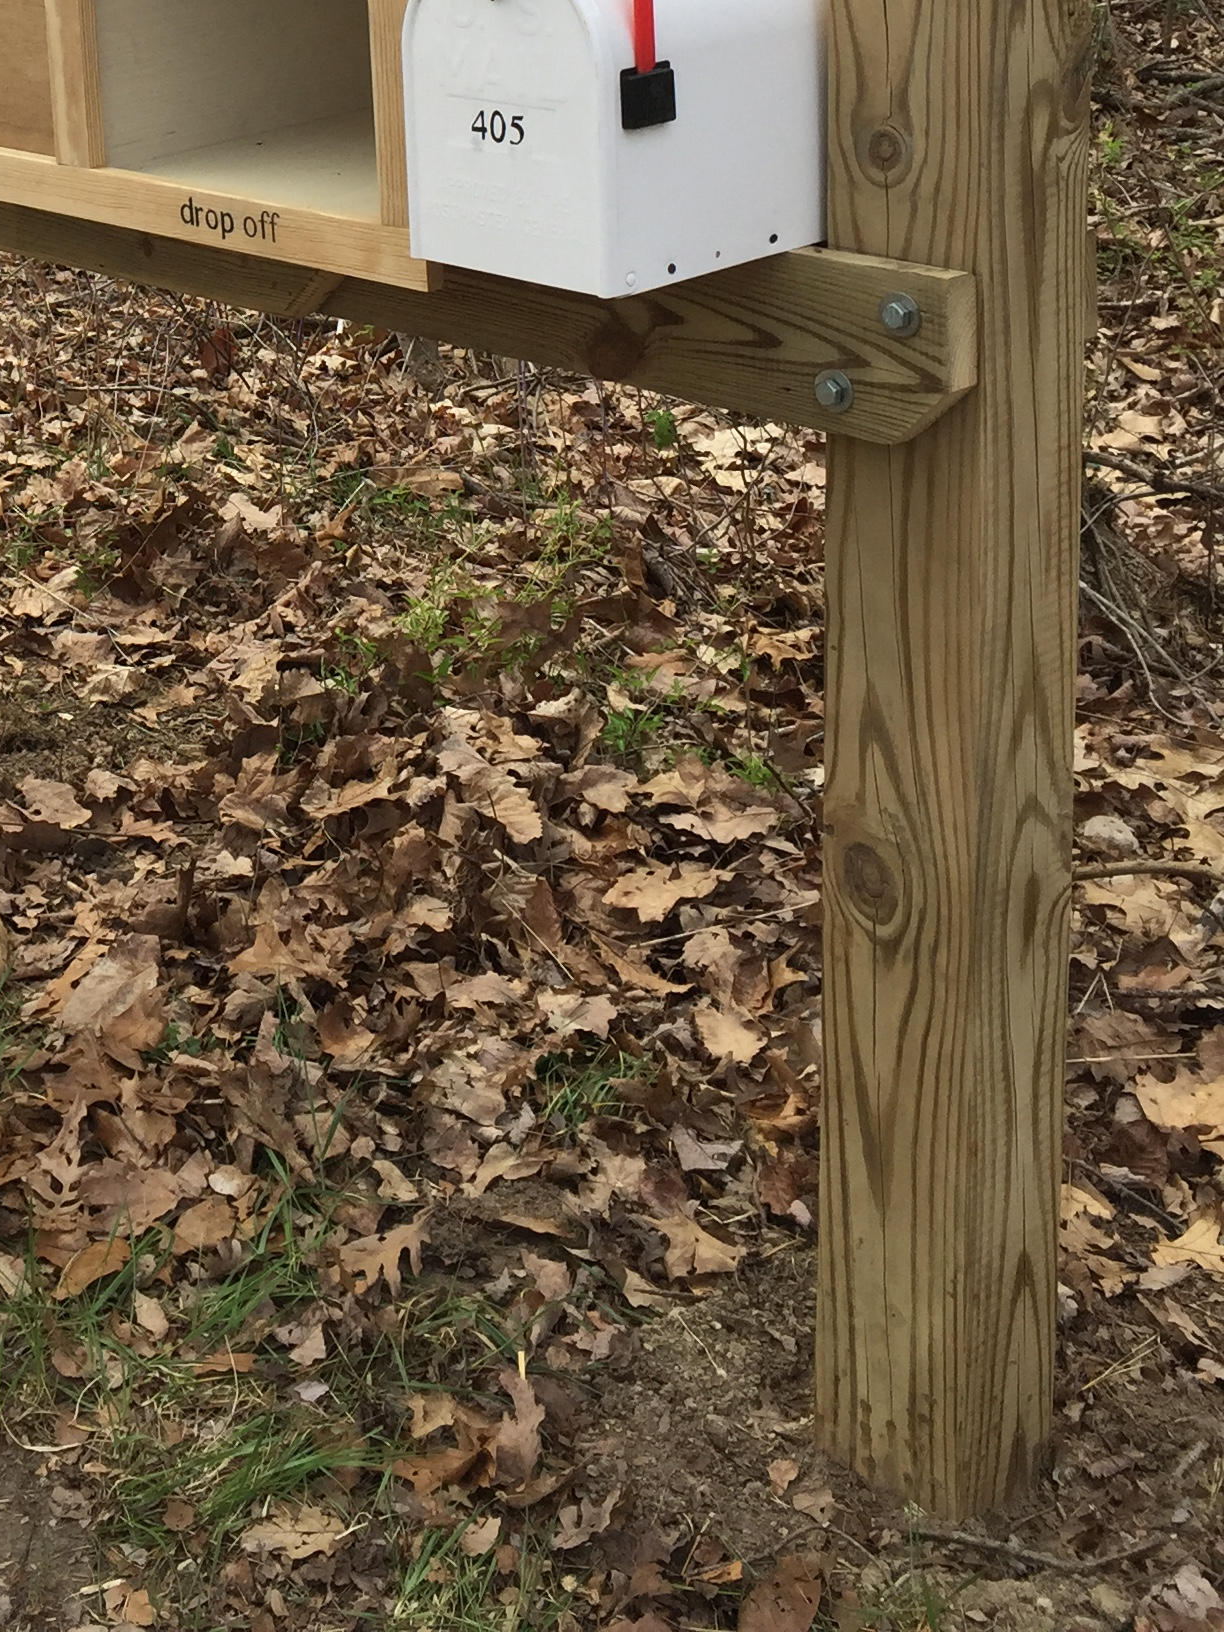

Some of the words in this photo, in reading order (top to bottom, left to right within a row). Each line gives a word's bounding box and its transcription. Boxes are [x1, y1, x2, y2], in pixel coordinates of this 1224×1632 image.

[471, 109, 525, 145] 405
[180, 196, 234, 240] drop
[243, 210, 281, 243] off
